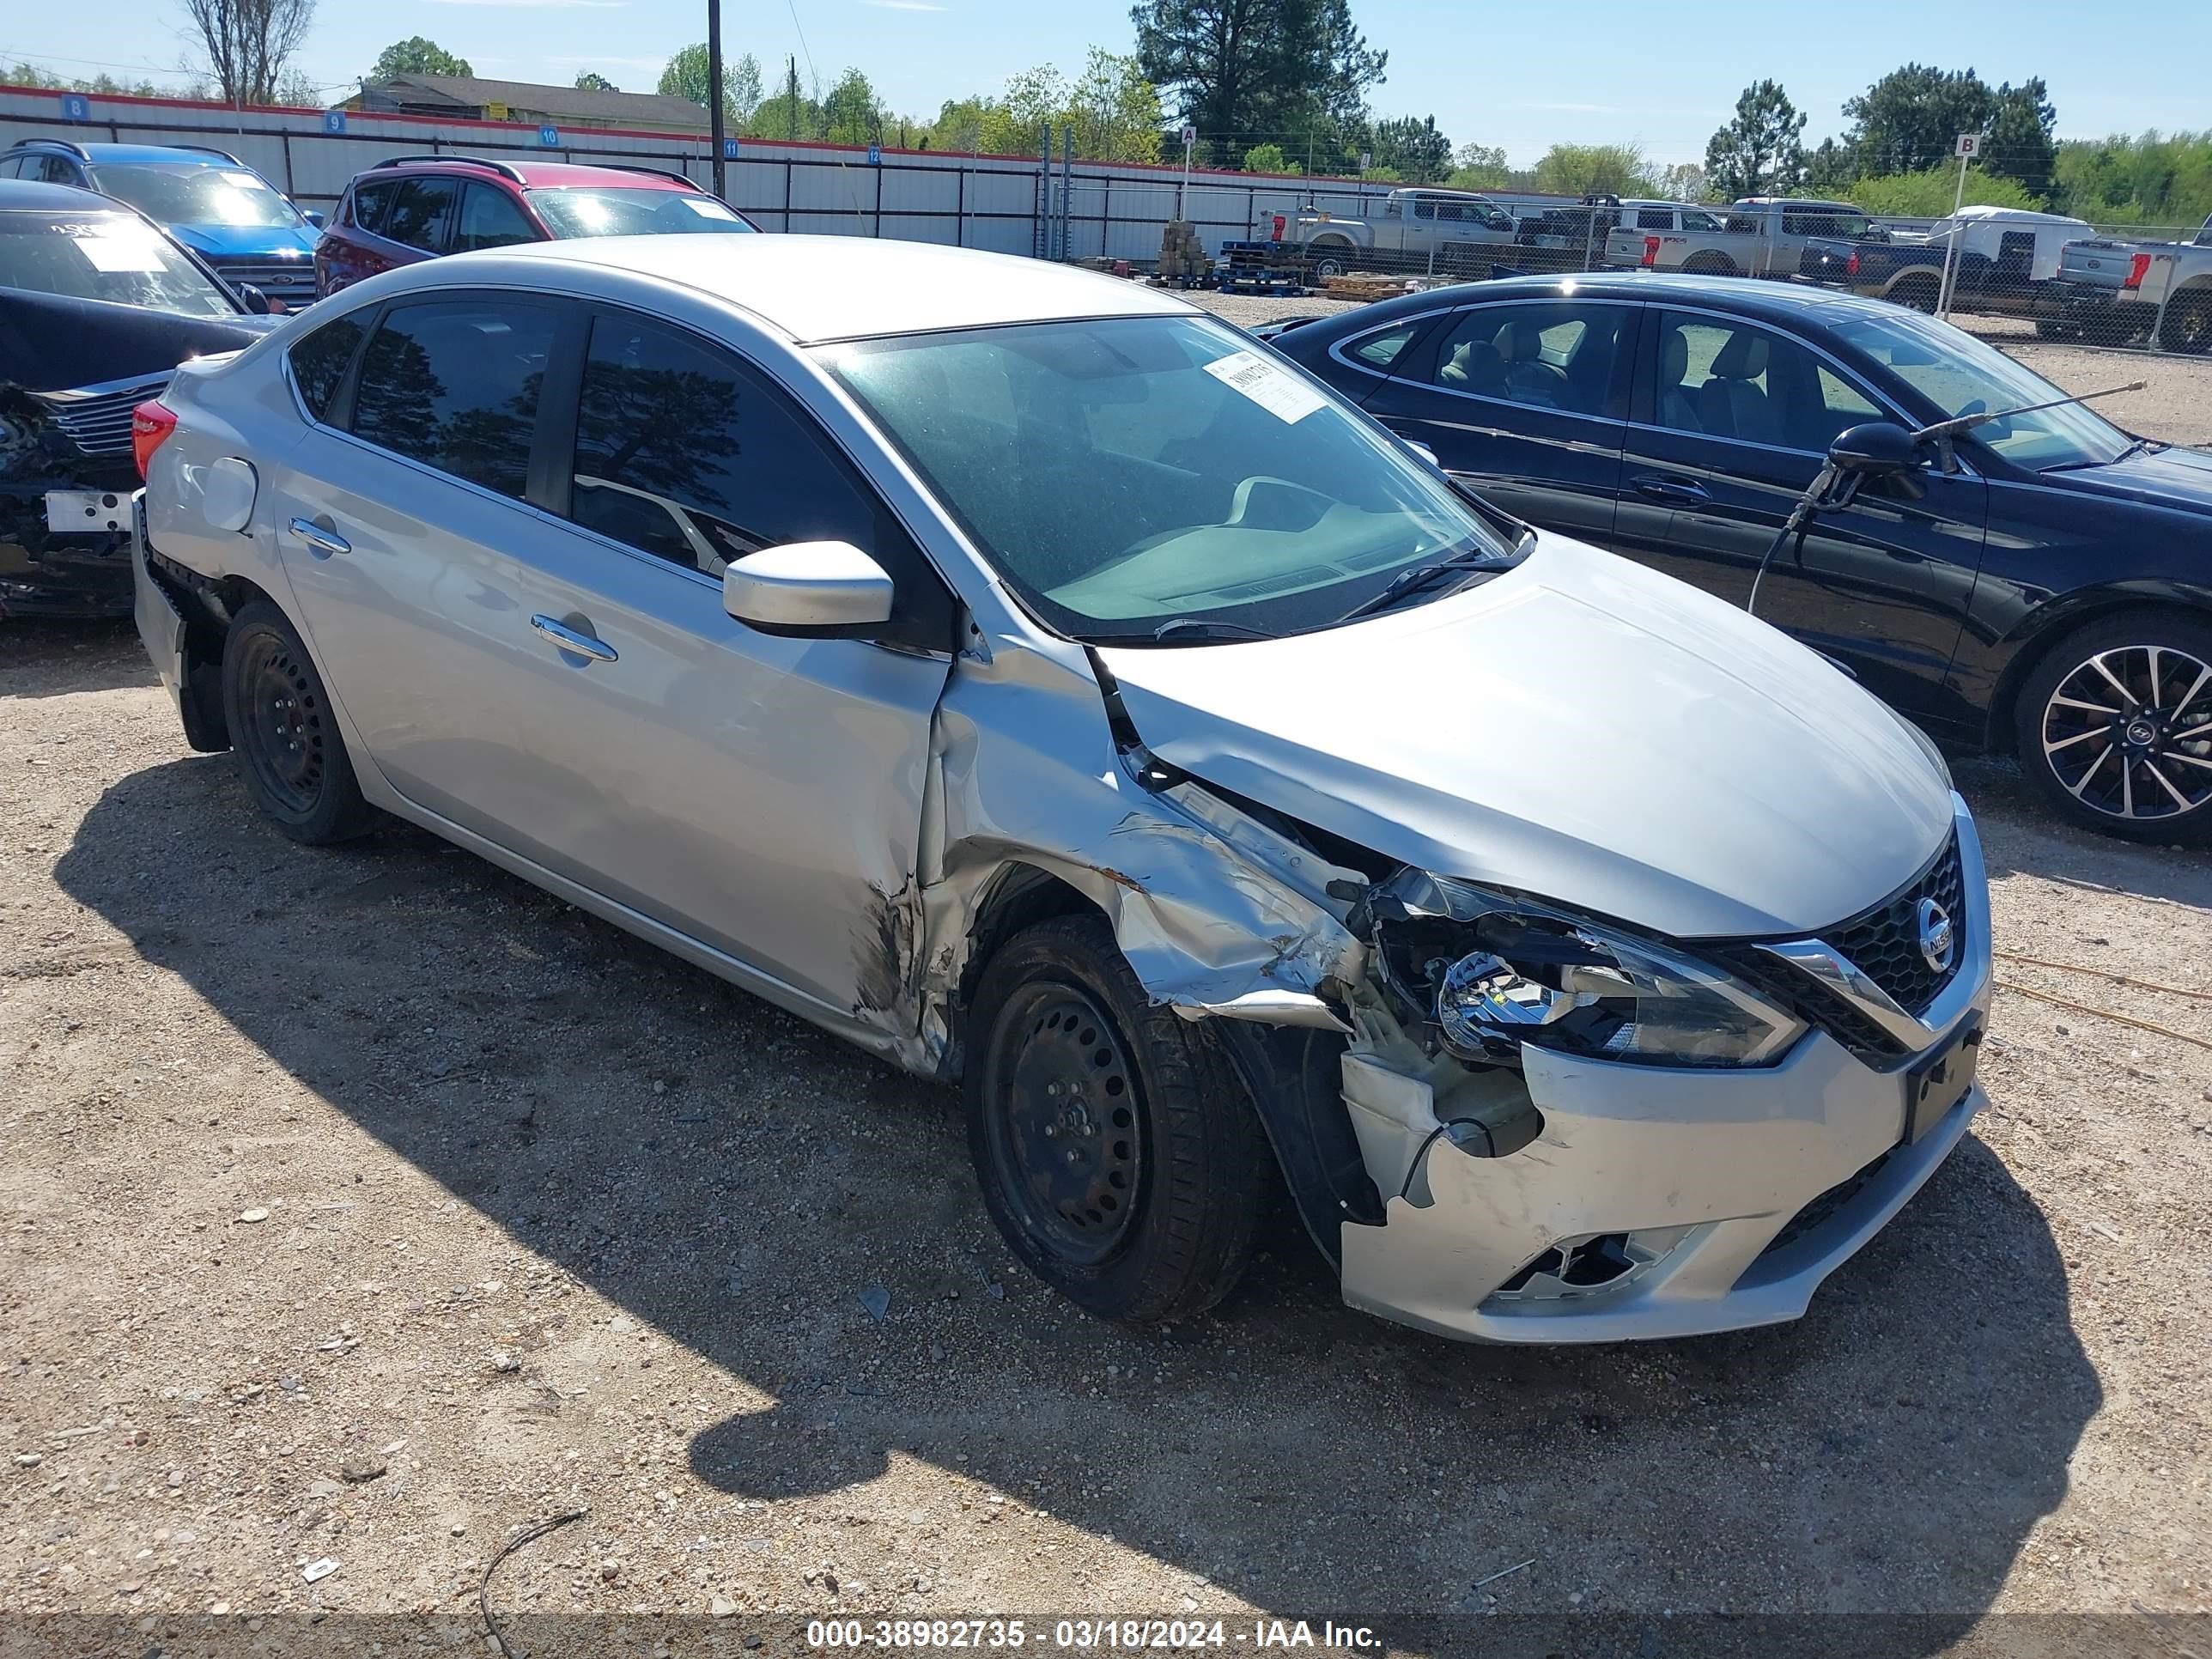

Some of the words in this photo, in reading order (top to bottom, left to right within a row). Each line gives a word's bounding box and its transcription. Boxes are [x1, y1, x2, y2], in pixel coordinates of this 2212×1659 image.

[71, 100, 82, 116] 8
[331, 116, 339, 130] 9
[543, 131, 556, 143] 10
[1185, 130, 1193, 140] A
[726, 143, 736, 155] 11
[1962, 138, 1973, 152] B
[870, 150, 878, 161] 12
[1929, 928, 1951, 951] NISS
